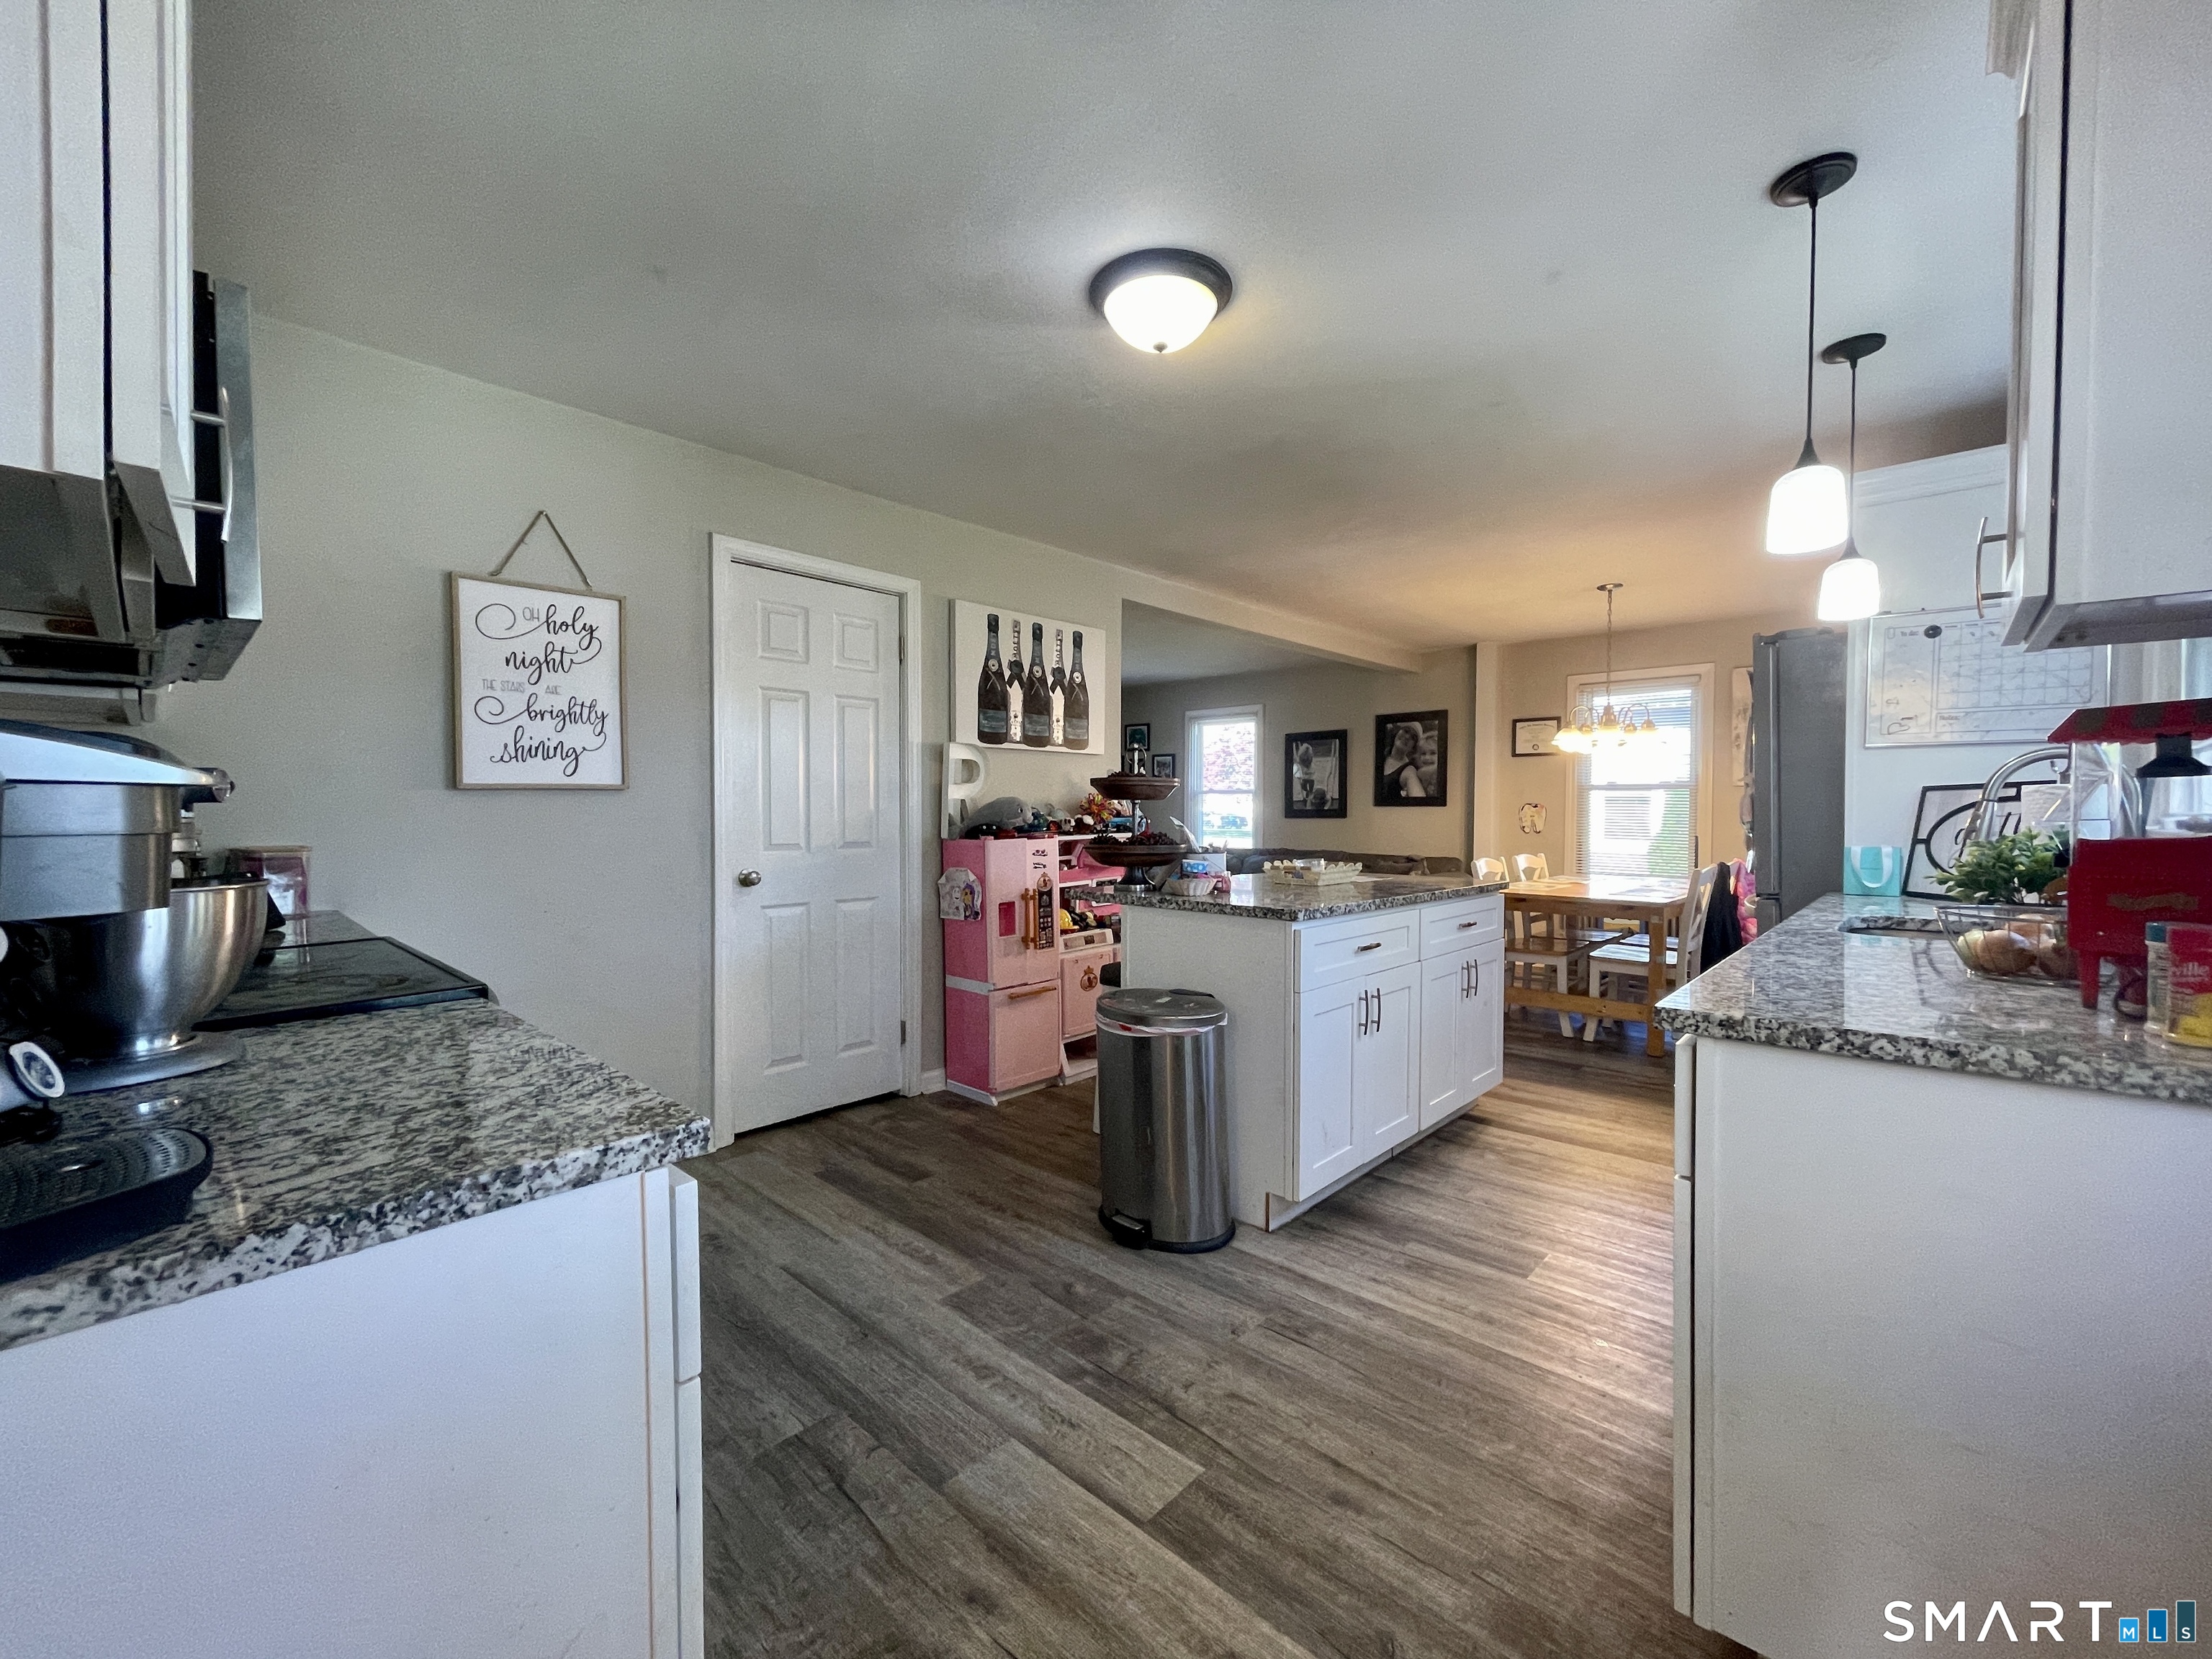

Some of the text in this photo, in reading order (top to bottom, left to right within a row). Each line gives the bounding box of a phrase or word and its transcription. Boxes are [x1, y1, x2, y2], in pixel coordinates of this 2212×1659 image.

[523, 606, 539, 621] OH
[505, 641, 578, 685] night
[482, 678, 497, 691] THE
[490, 725, 582, 777] shining
